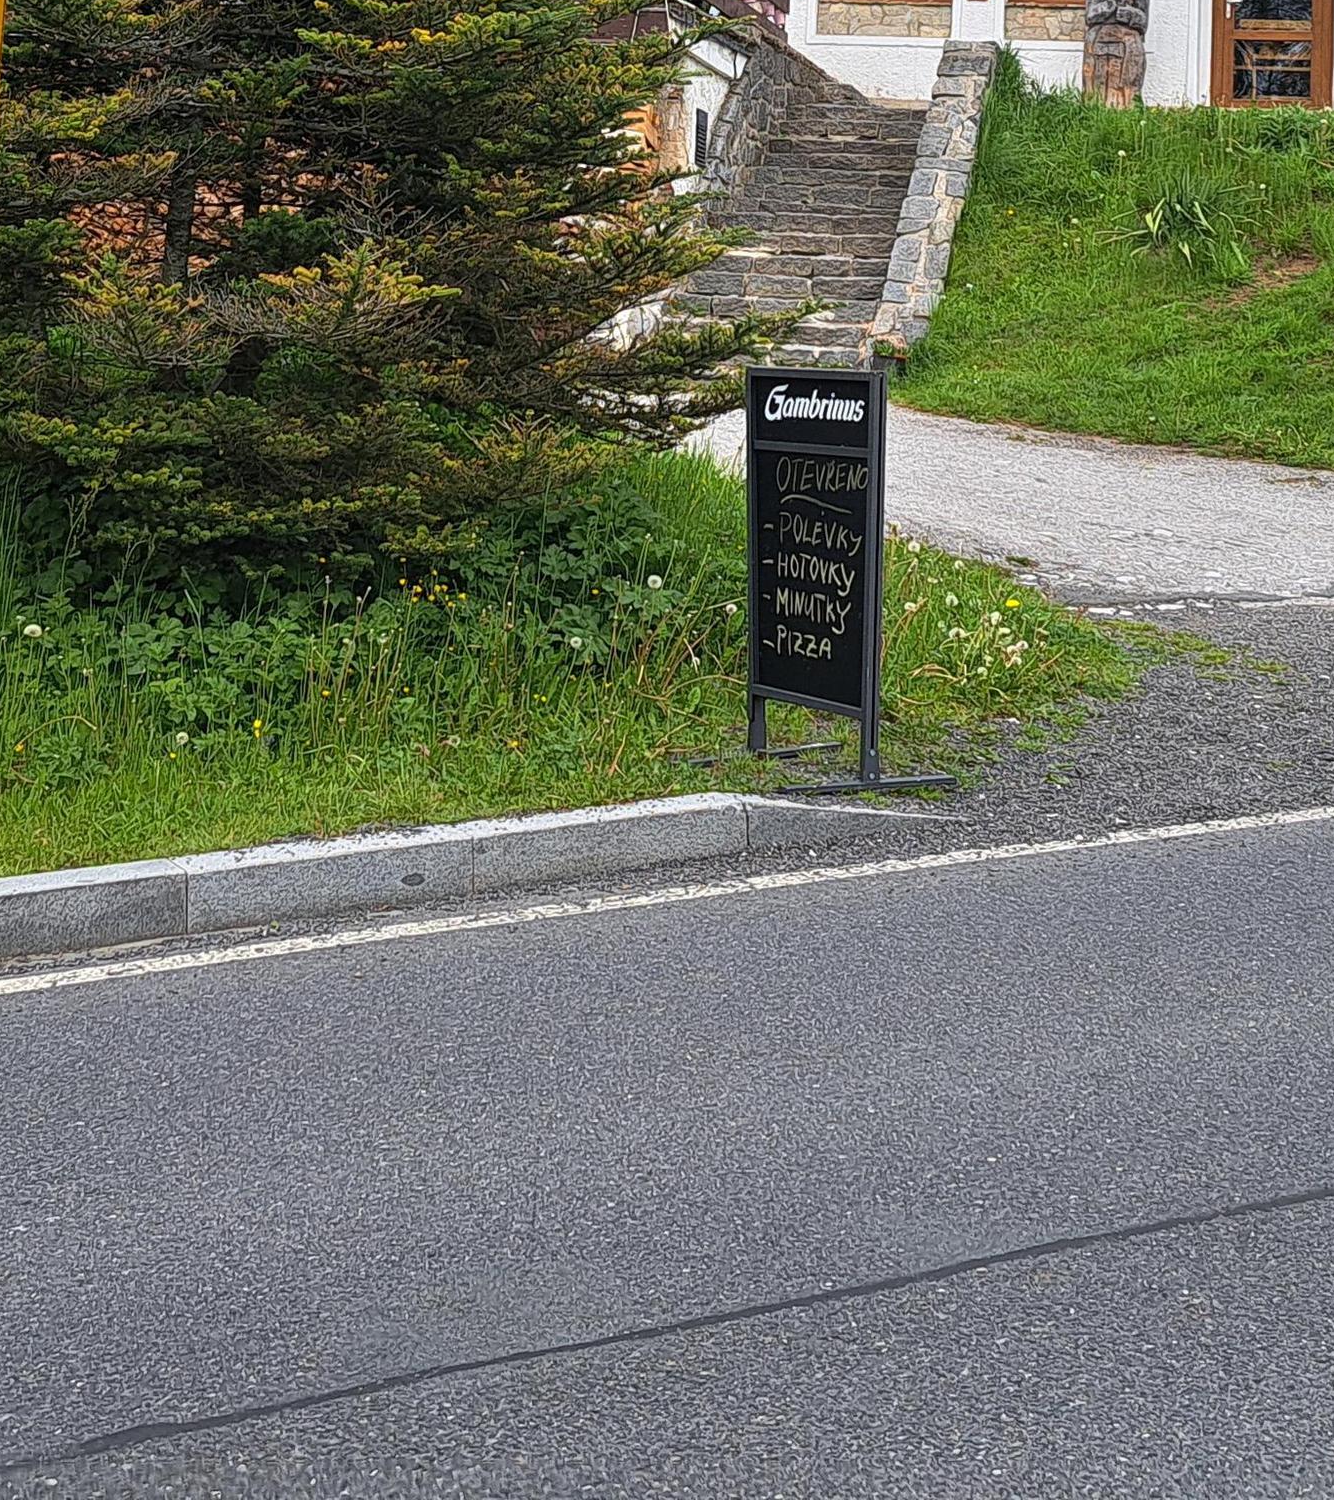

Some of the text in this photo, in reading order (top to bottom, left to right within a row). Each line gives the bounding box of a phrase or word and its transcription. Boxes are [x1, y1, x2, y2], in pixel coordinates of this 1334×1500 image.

[765, 384, 865, 422] Gambrinus
[776, 457, 869, 492] OTEVŘENO
[777, 552, 855, 596] HOTOVKY
[776, 586, 851, 634] MINUTKY
[777, 624, 832, 660] PIZZA
